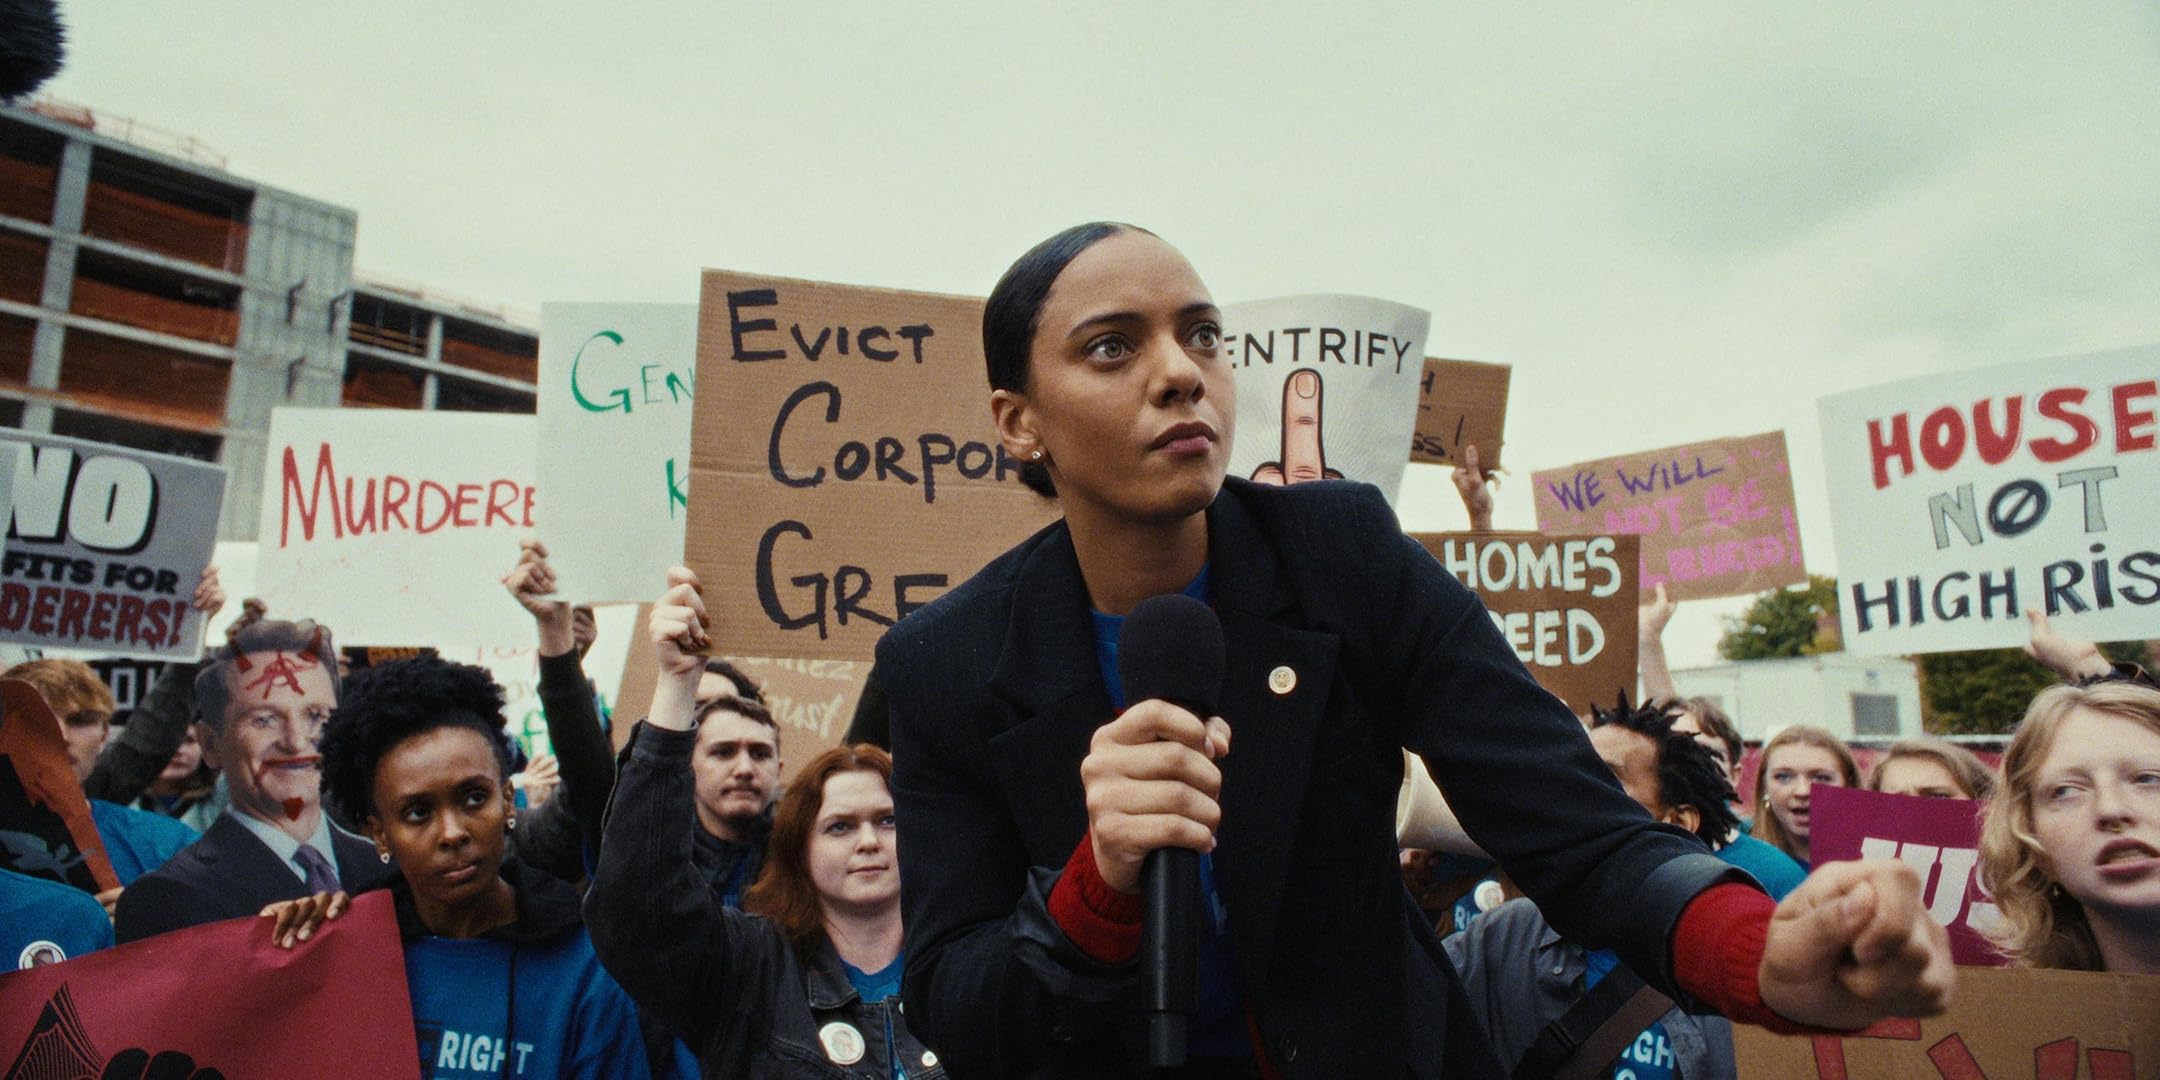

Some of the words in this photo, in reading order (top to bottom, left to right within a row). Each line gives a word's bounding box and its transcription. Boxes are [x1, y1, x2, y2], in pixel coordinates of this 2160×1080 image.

[727, 289, 935, 363] EVICT
[1867, 380, 2159, 490] HOUSE
[6, 443, 160, 555] NO
[1551, 470, 1605, 512] WE
[1617, 457, 1726, 496] WILL
[1604, 496, 1684, 535] NOT
[1705, 480, 1769, 528] BE
[1928, 466, 2119, 550] NOT
[104, 562, 179, 594] FOR
[1444, 536, 1622, 597] HOMES
[1852, 567, 2019, 633] HIGH
